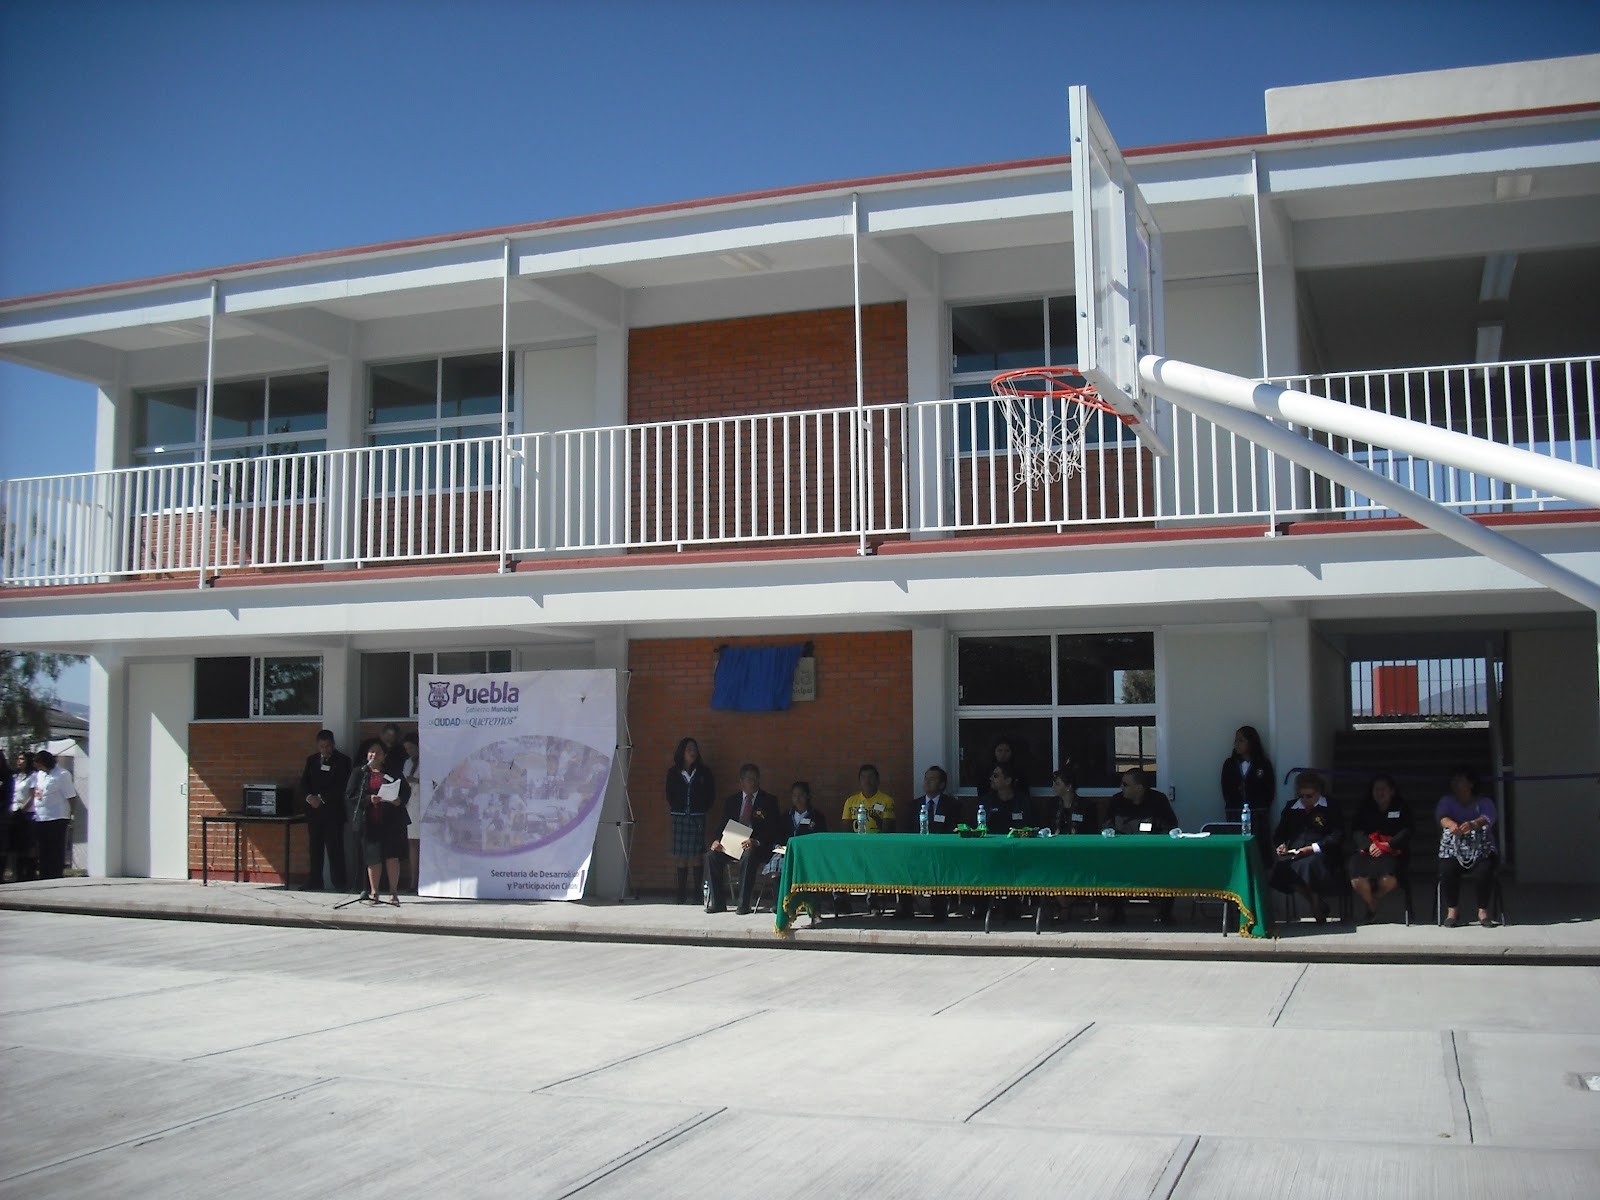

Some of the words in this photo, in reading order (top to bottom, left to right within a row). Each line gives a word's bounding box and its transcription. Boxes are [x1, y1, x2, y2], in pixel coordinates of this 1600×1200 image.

[452, 681, 519, 704] Puebla
[491, 705, 519, 714] Municipal
[434, 717, 461, 727] CIUDAD
[529, 870, 538, 878] de
[507, 883, 513, 891] y
[513, 882, 560, 891] Participación
